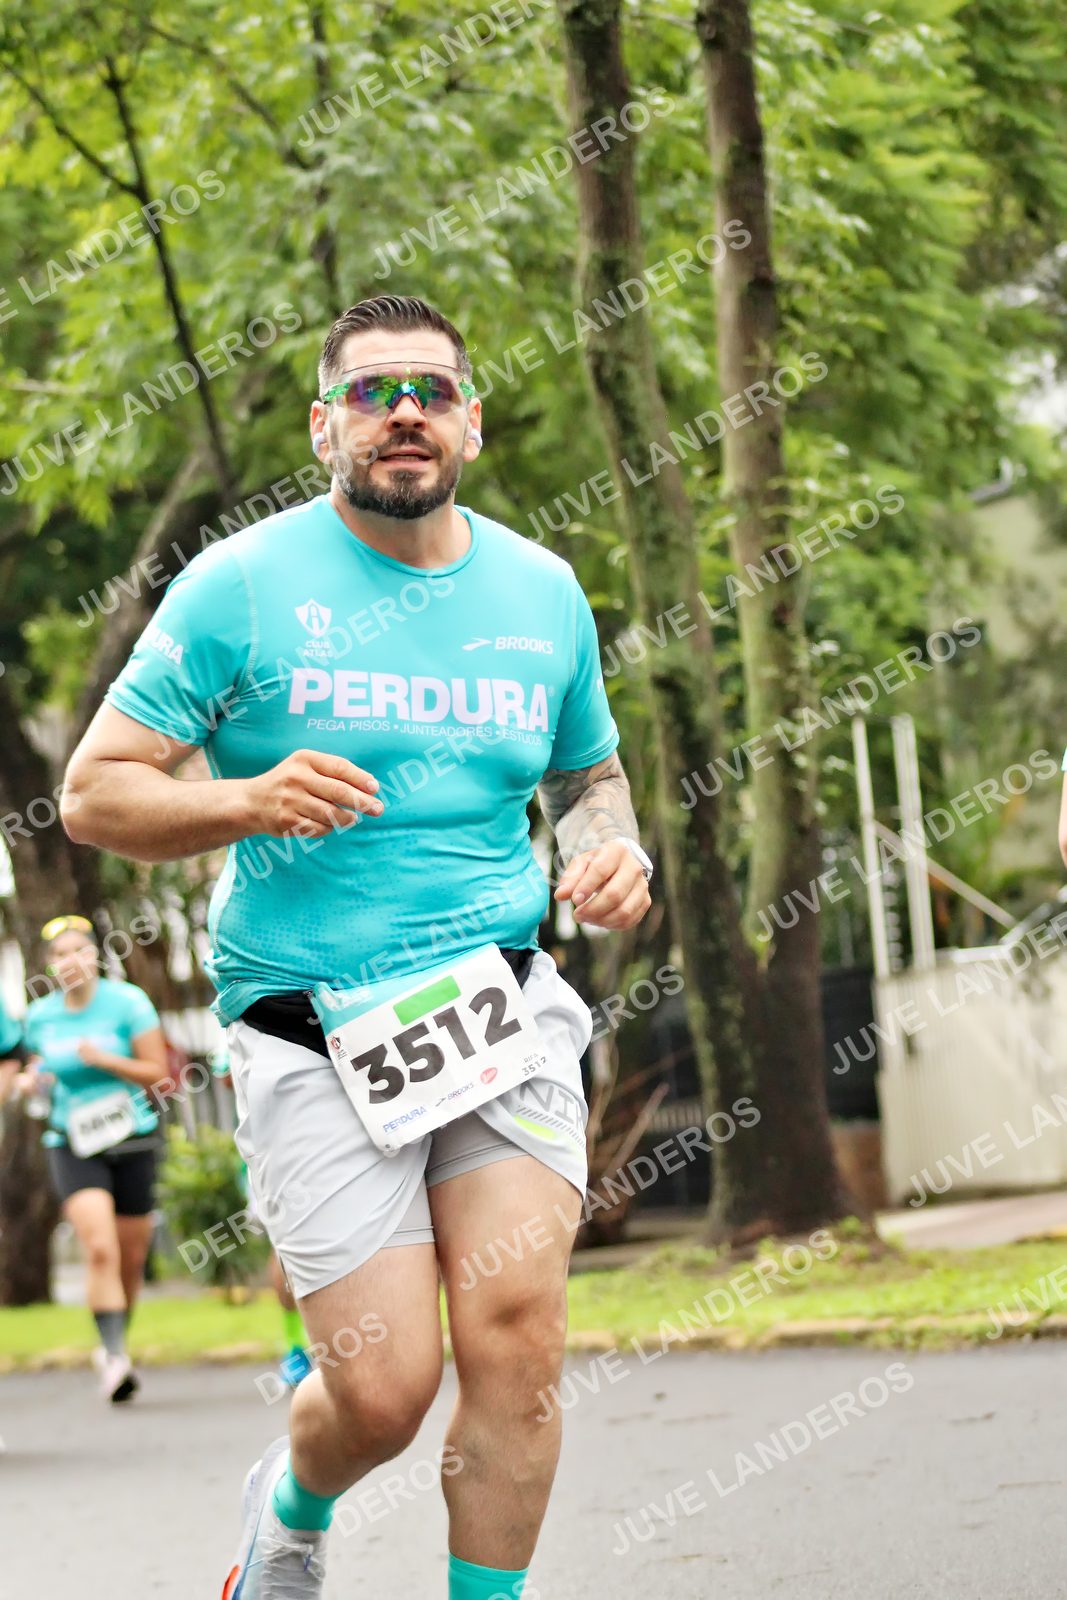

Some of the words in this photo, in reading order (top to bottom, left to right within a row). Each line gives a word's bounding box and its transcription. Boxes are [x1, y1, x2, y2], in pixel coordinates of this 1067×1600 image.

[495, 636, 554, 654] BROOKS
[288, 667, 549, 733] PERDURA
[307, 718, 346, 731] PEGA
[350, 719, 391, 732] PISOS
[400, 724, 493, 737] JUNTEADORES
[350, 986, 522, 1104] 3512
[521, 1056, 547, 1076] 3512
[383, 1106, 427, 1133] PERDURA
[447, 1082, 474, 1101] BROOKS
